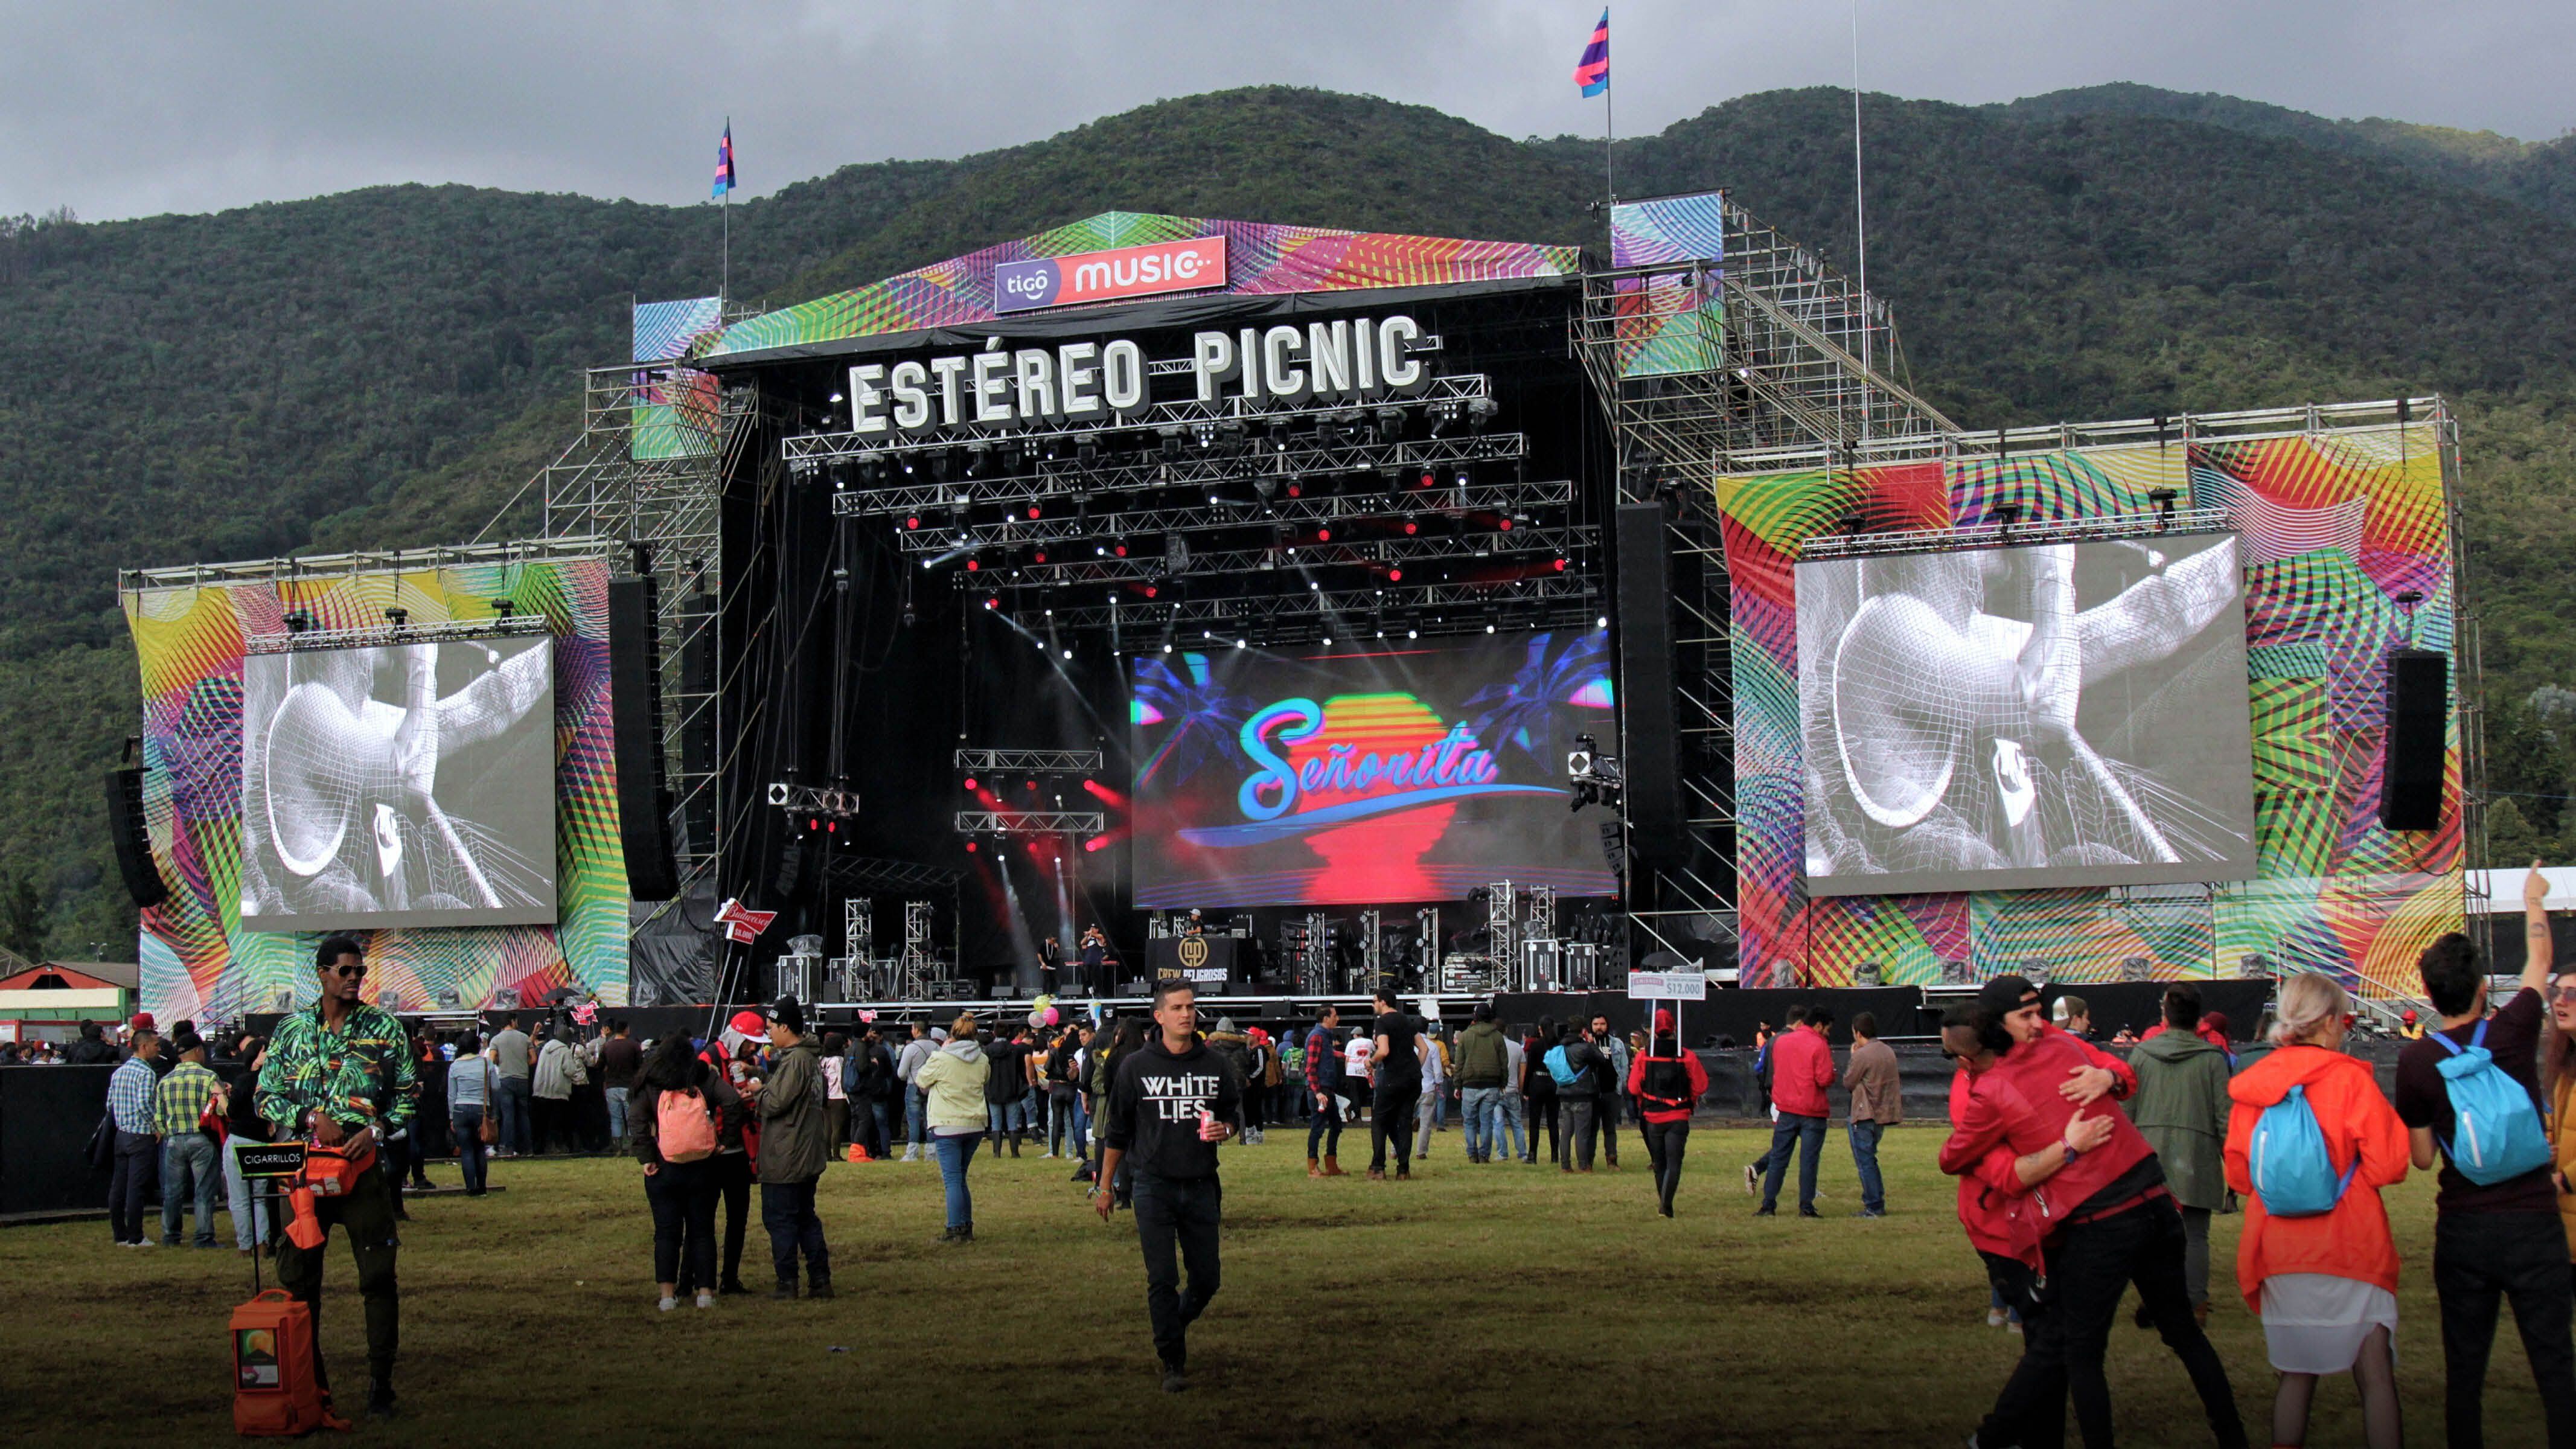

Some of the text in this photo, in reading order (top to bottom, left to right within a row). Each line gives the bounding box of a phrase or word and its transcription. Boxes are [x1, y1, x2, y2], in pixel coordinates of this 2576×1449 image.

[849, 316, 1422, 433] ESTÉREO PICNIC
[1238, 697, 1496, 821] Señorita
[726, 905, 769, 926] Budweiser
[1183, 968, 1228, 982] PELIGROSOS
[1159, 1099, 1206, 1124] LIES
[244, 1153, 301, 1165] CIGARRILLOS
